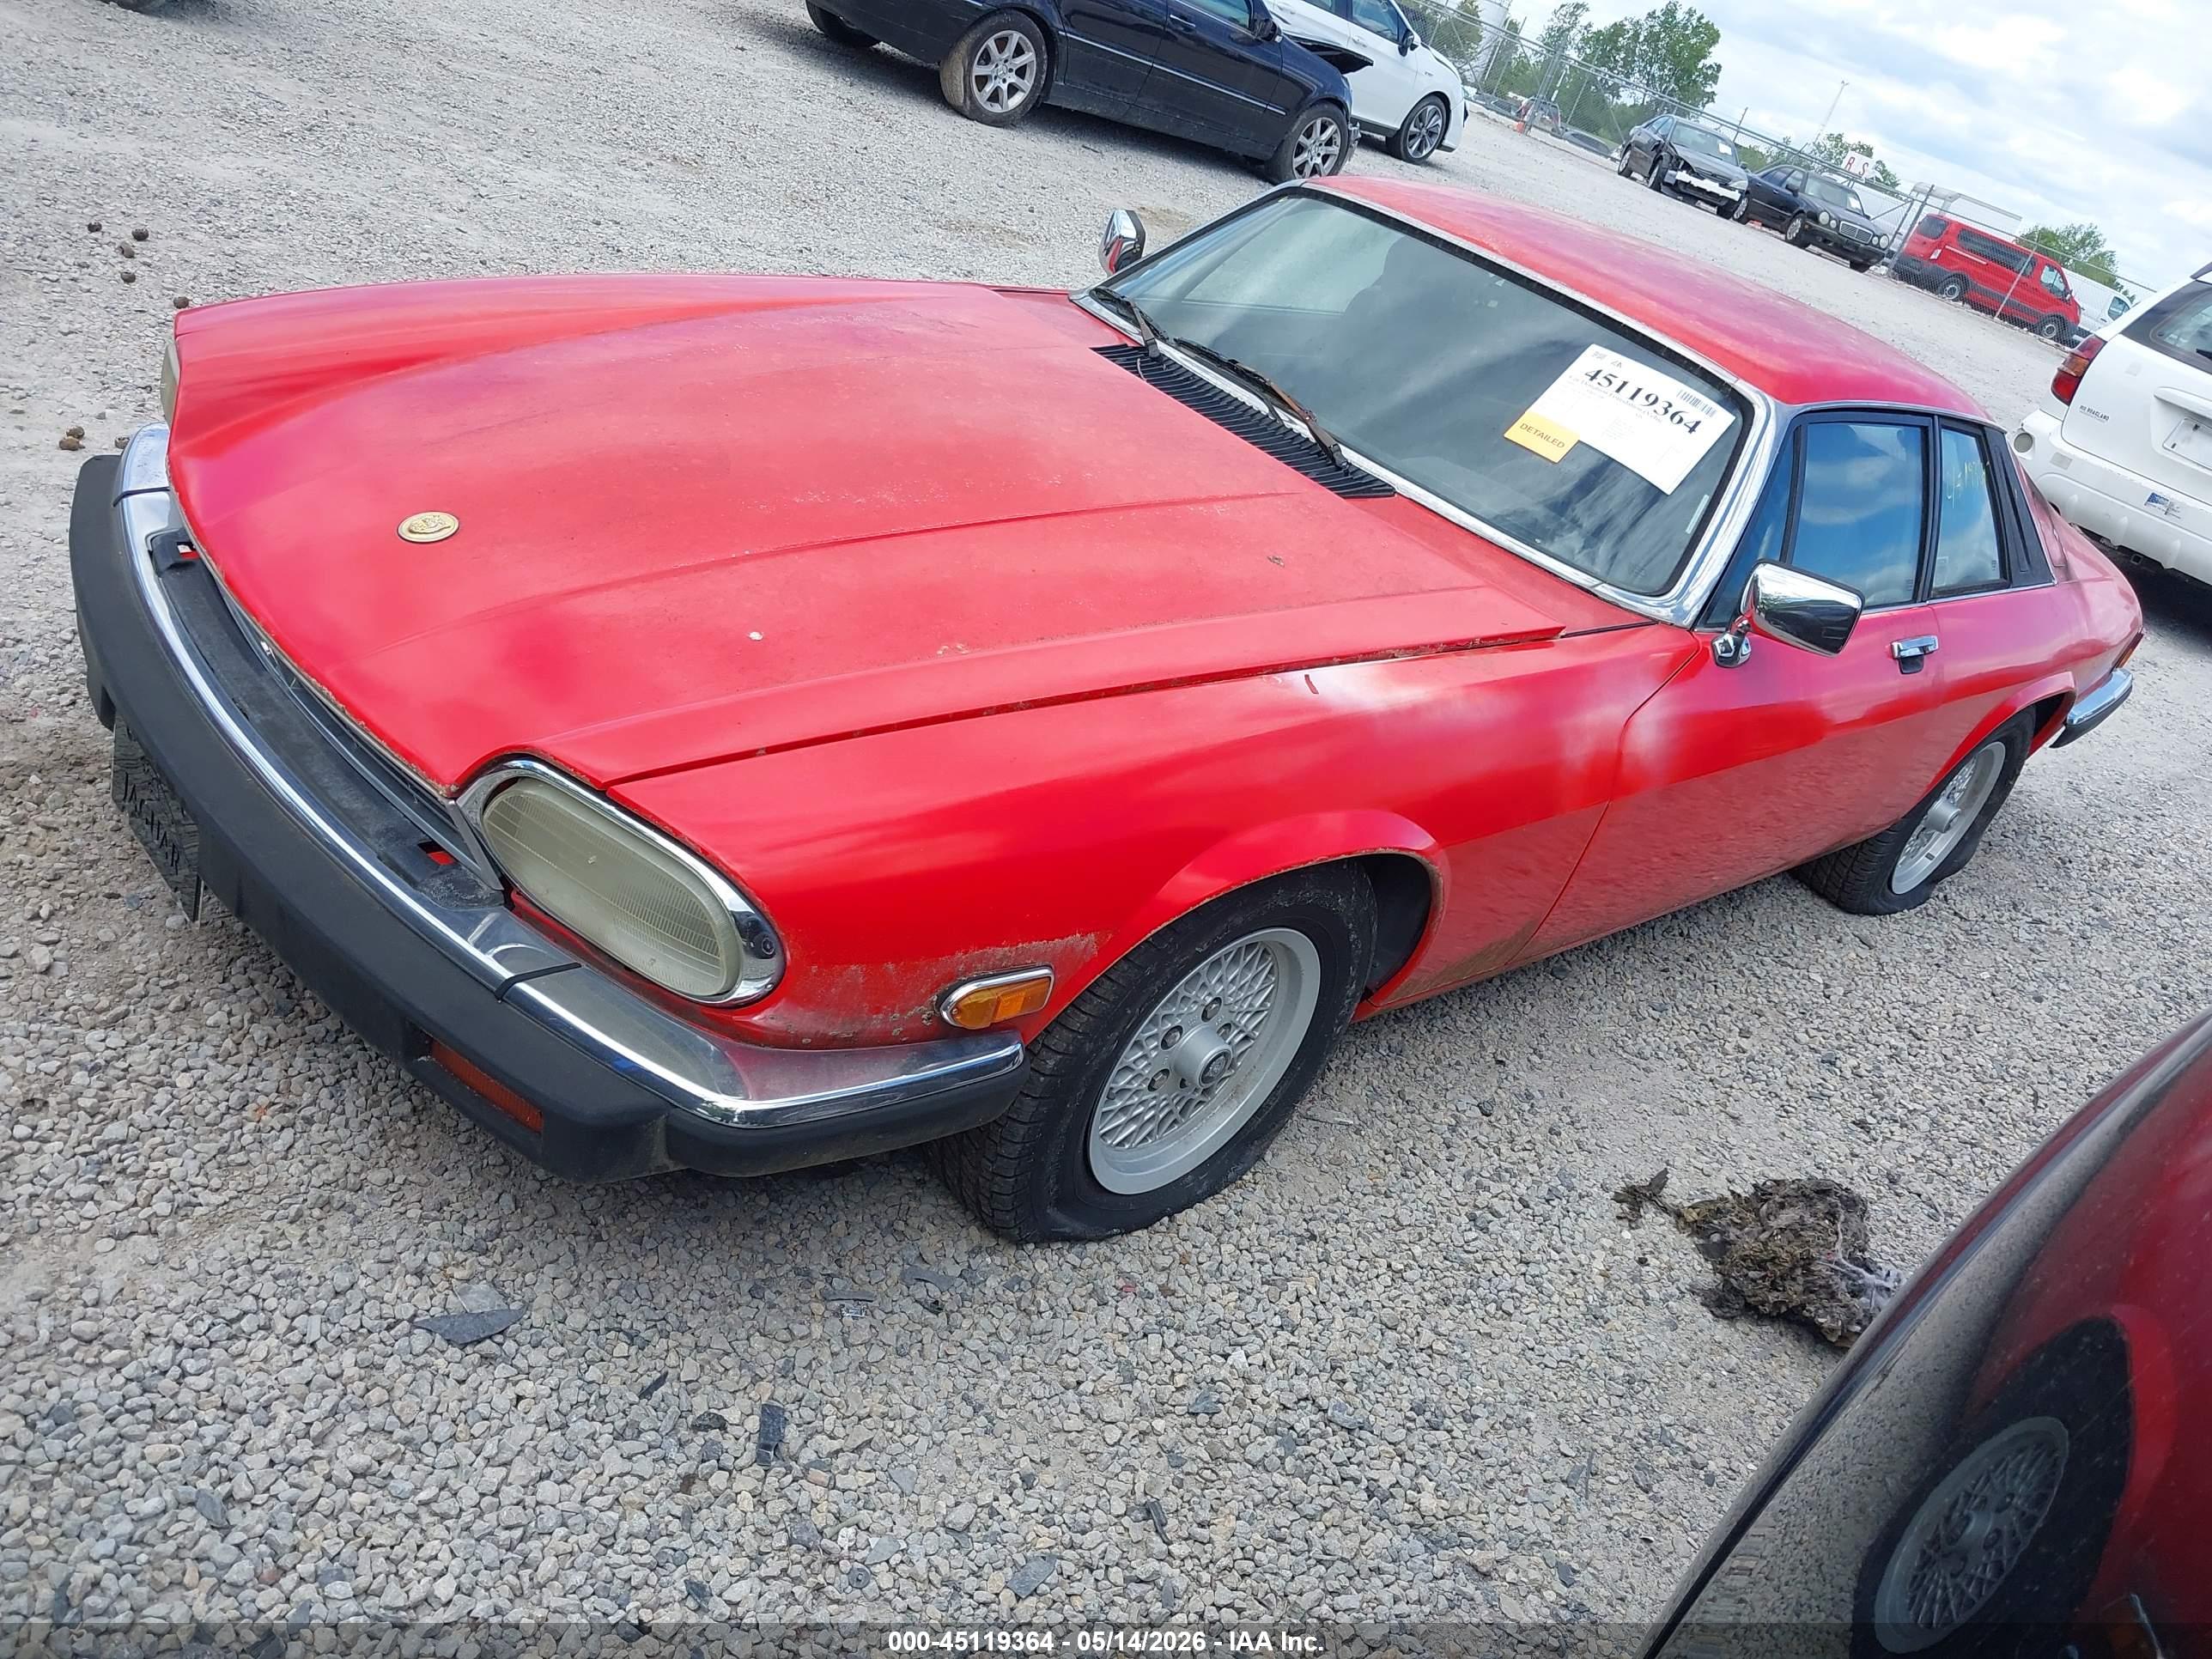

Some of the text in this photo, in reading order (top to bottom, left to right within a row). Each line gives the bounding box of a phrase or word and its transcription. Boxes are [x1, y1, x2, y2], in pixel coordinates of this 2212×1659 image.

[1844, 156, 1869, 176] R S
[1584, 368, 1702, 434] 45119364
[1519, 422, 1565, 449] DETAILED
